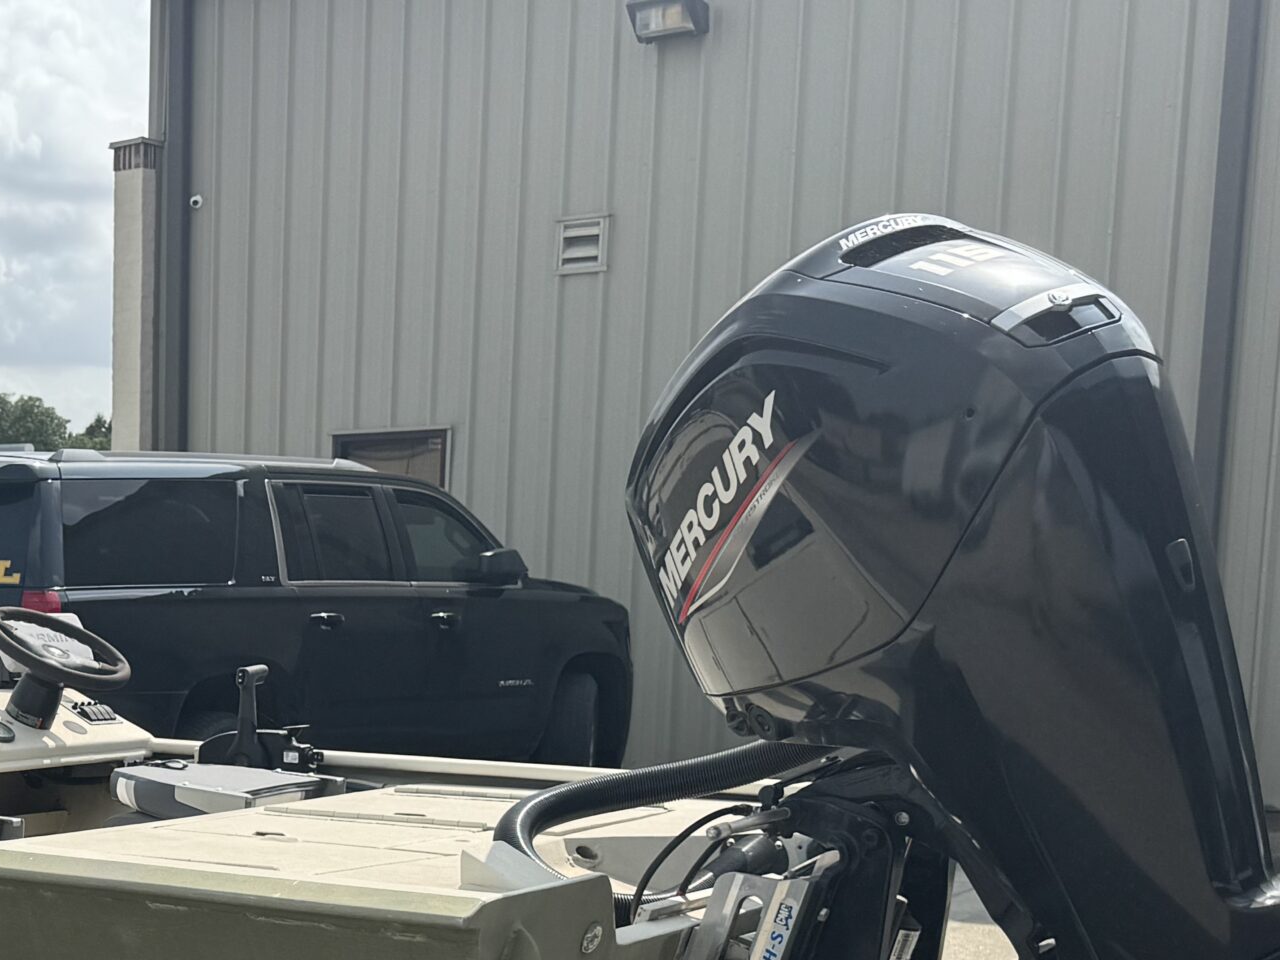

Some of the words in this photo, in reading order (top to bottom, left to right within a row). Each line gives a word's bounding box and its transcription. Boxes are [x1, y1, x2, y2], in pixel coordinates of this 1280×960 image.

[837, 215, 924, 251] MERCURY
[908, 244, 1006, 277] 115
[658, 389, 777, 607] MERCURY
[774, 903, 793, 927] CMC
